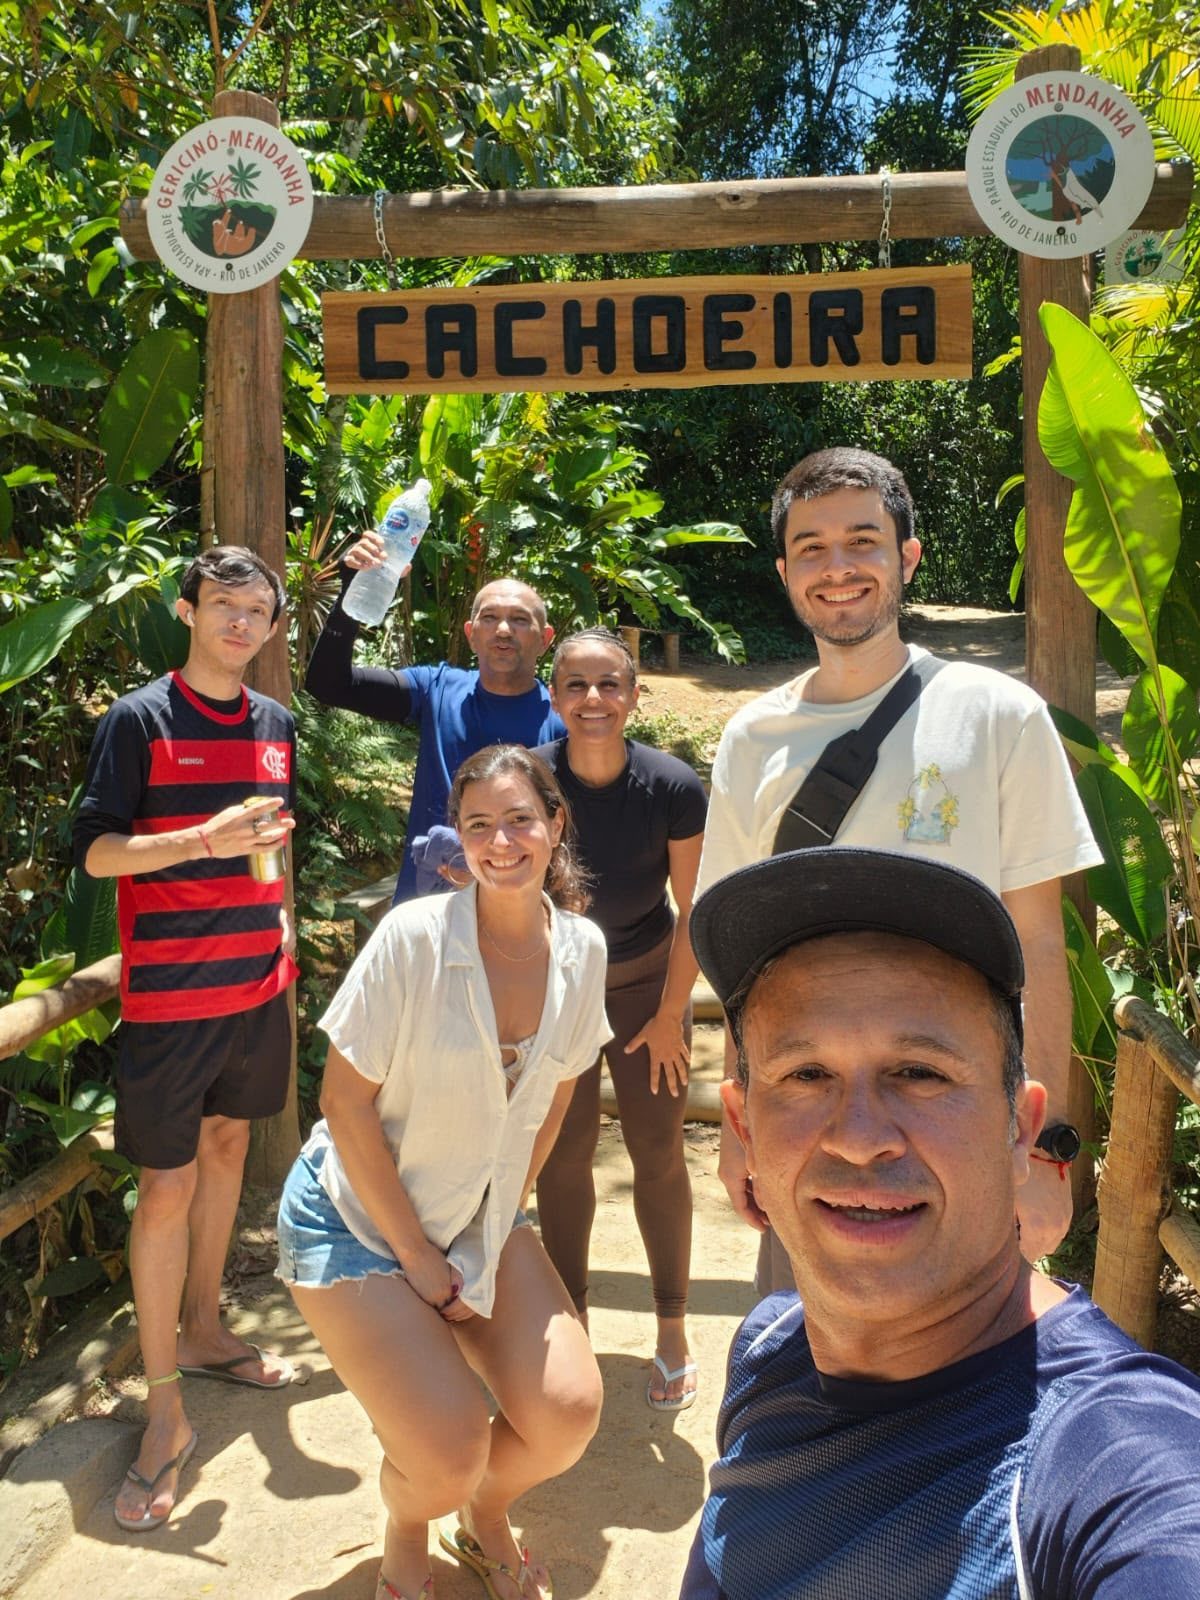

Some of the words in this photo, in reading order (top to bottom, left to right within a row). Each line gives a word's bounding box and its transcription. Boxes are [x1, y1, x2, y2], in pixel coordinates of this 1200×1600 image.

[1010, 103, 1026, 119] DO
[1025, 83, 1136, 139] MENDANHA
[983, 116, 1014, 163] ESTADUAL
[157, 129, 305, 209] GERICINÓ-MENDANHA
[981, 164, 1001, 206] PARQUE
[161, 213, 173, 226] DE
[1001, 211, 1018, 229] RIO
[1019, 223, 1032, 239] DE
[1033, 232, 1078, 246] JANEIRO
[164, 228, 194, 268] ESTADUAL
[220, 269, 236, 281] RIO
[239, 269, 252, 280] DE
[253, 241, 286, 275] JANEIRO
[195, 263, 212, 278] APA
[357, 285, 937, 380] CACHOEIRA
